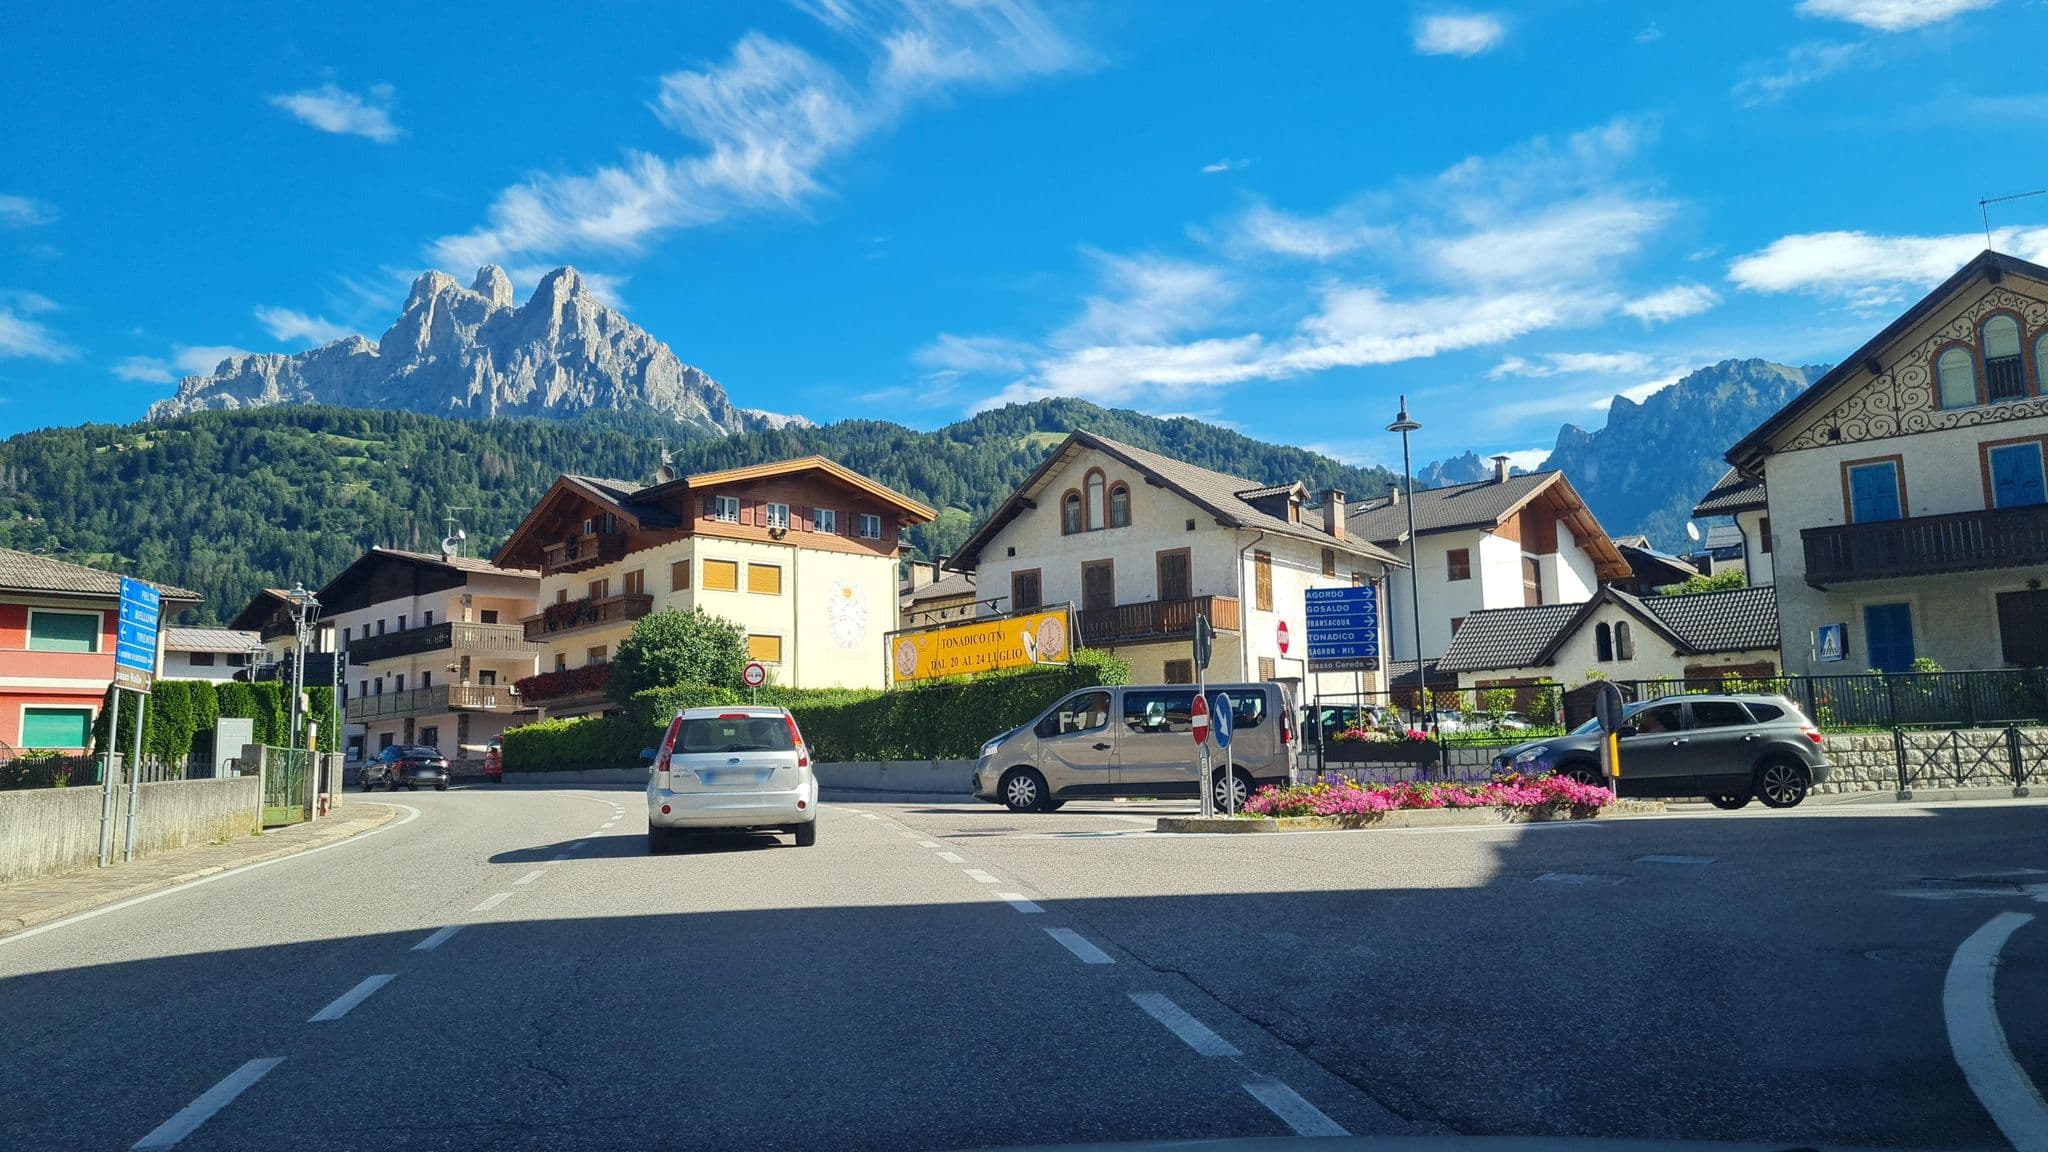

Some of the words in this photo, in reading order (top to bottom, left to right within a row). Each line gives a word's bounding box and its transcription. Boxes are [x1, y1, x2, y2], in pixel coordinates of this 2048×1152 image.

[1306, 590, 1344, 599] AGORDO
[1307, 605, 1350, 613] GOSALDO
[941, 633, 986, 649] TONADICO
[987, 631, 1006, 645] (TN)
[1308, 633, 1354, 641] TONADICO
[931, 659, 947, 671] DAL
[950, 657, 959, 667] 20
[962, 655, 973, 666] AL
[976, 654, 985, 665] 24
[988, 648, 1023, 664] LUGLIO
[1335, 660, 1364, 668] Cereda
